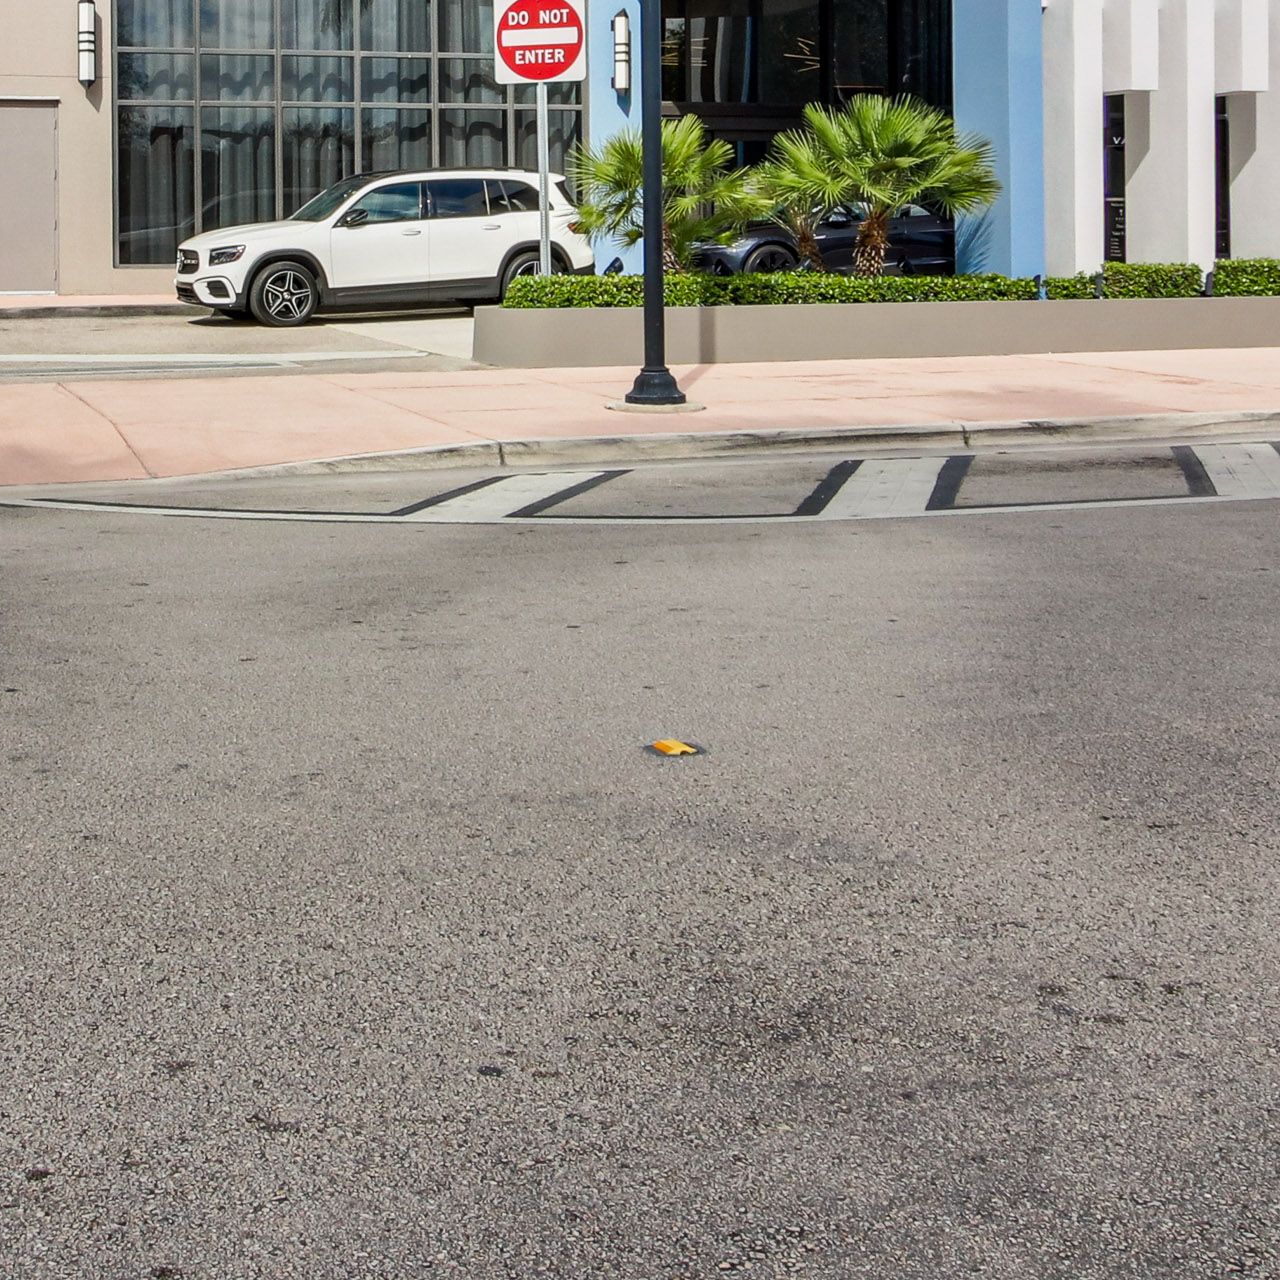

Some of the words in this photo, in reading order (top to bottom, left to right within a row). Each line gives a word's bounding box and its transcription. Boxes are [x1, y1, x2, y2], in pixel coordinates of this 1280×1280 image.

[508, 11, 529, 25] DO
[539, 9, 569, 24] NOT
[515, 49, 564, 64] ENTER
